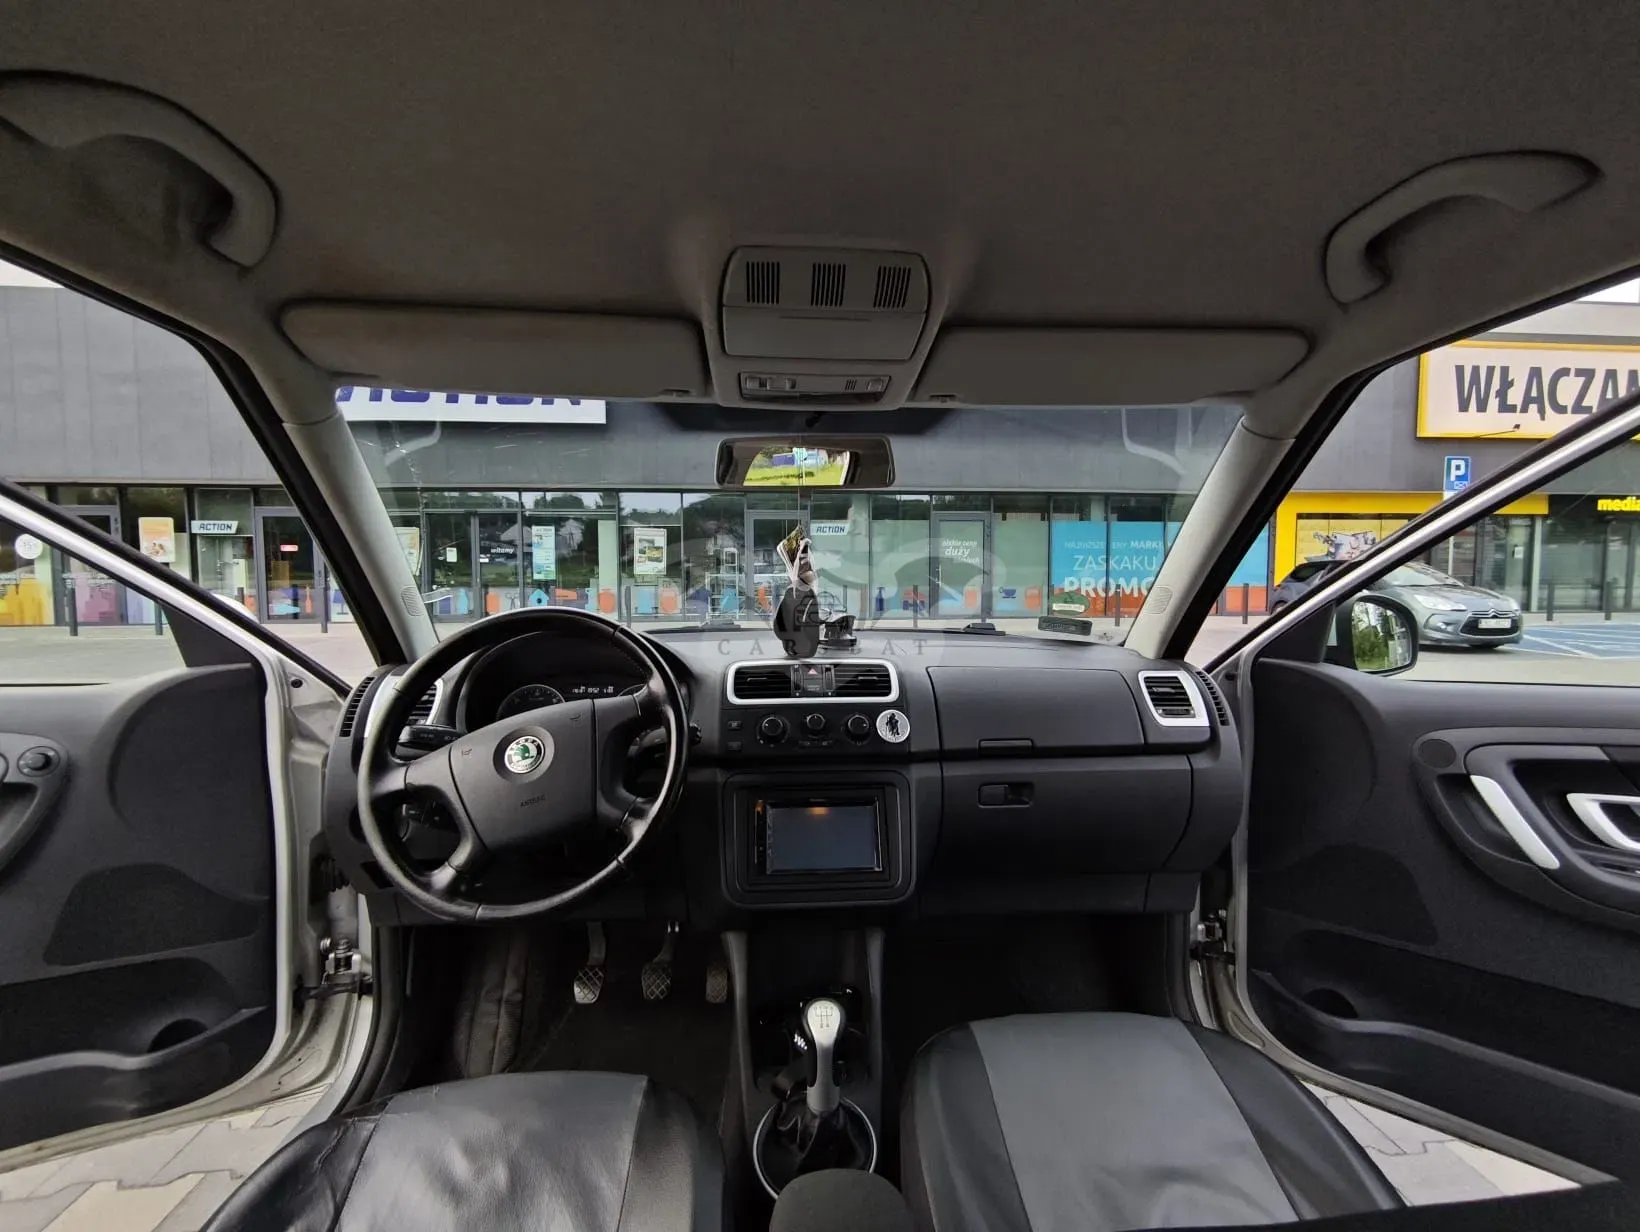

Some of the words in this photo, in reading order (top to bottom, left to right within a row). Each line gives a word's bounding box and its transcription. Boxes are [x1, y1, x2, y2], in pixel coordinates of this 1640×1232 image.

[1450, 459, 1466, 482] P
[199, 523, 233, 531] ACTION
[816, 525, 846, 533] ACTION
